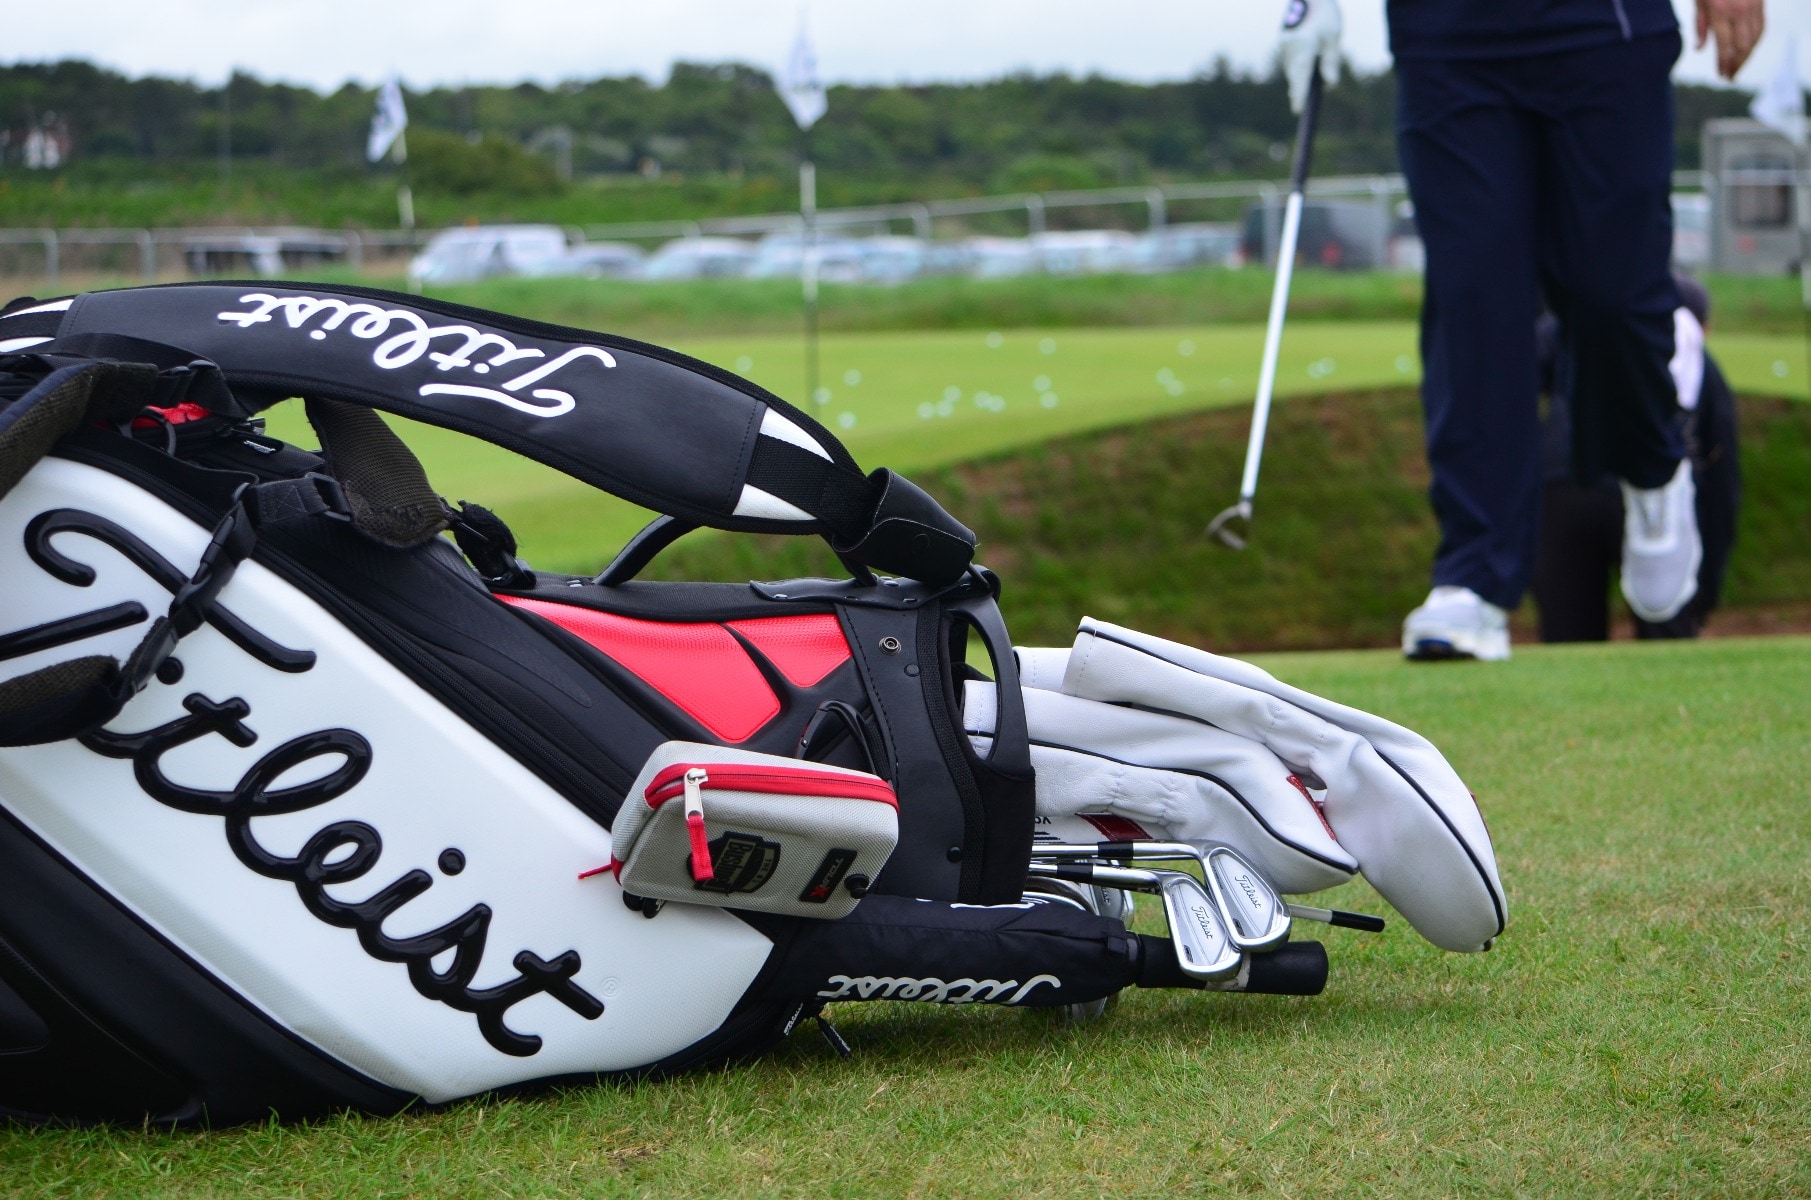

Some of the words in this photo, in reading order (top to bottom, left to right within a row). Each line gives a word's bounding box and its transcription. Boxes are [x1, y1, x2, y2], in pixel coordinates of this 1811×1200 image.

[217, 293, 617, 418] Titleist
[1235, 874, 1262, 909] Titleist
[1191, 906, 1214, 939] Titleist
